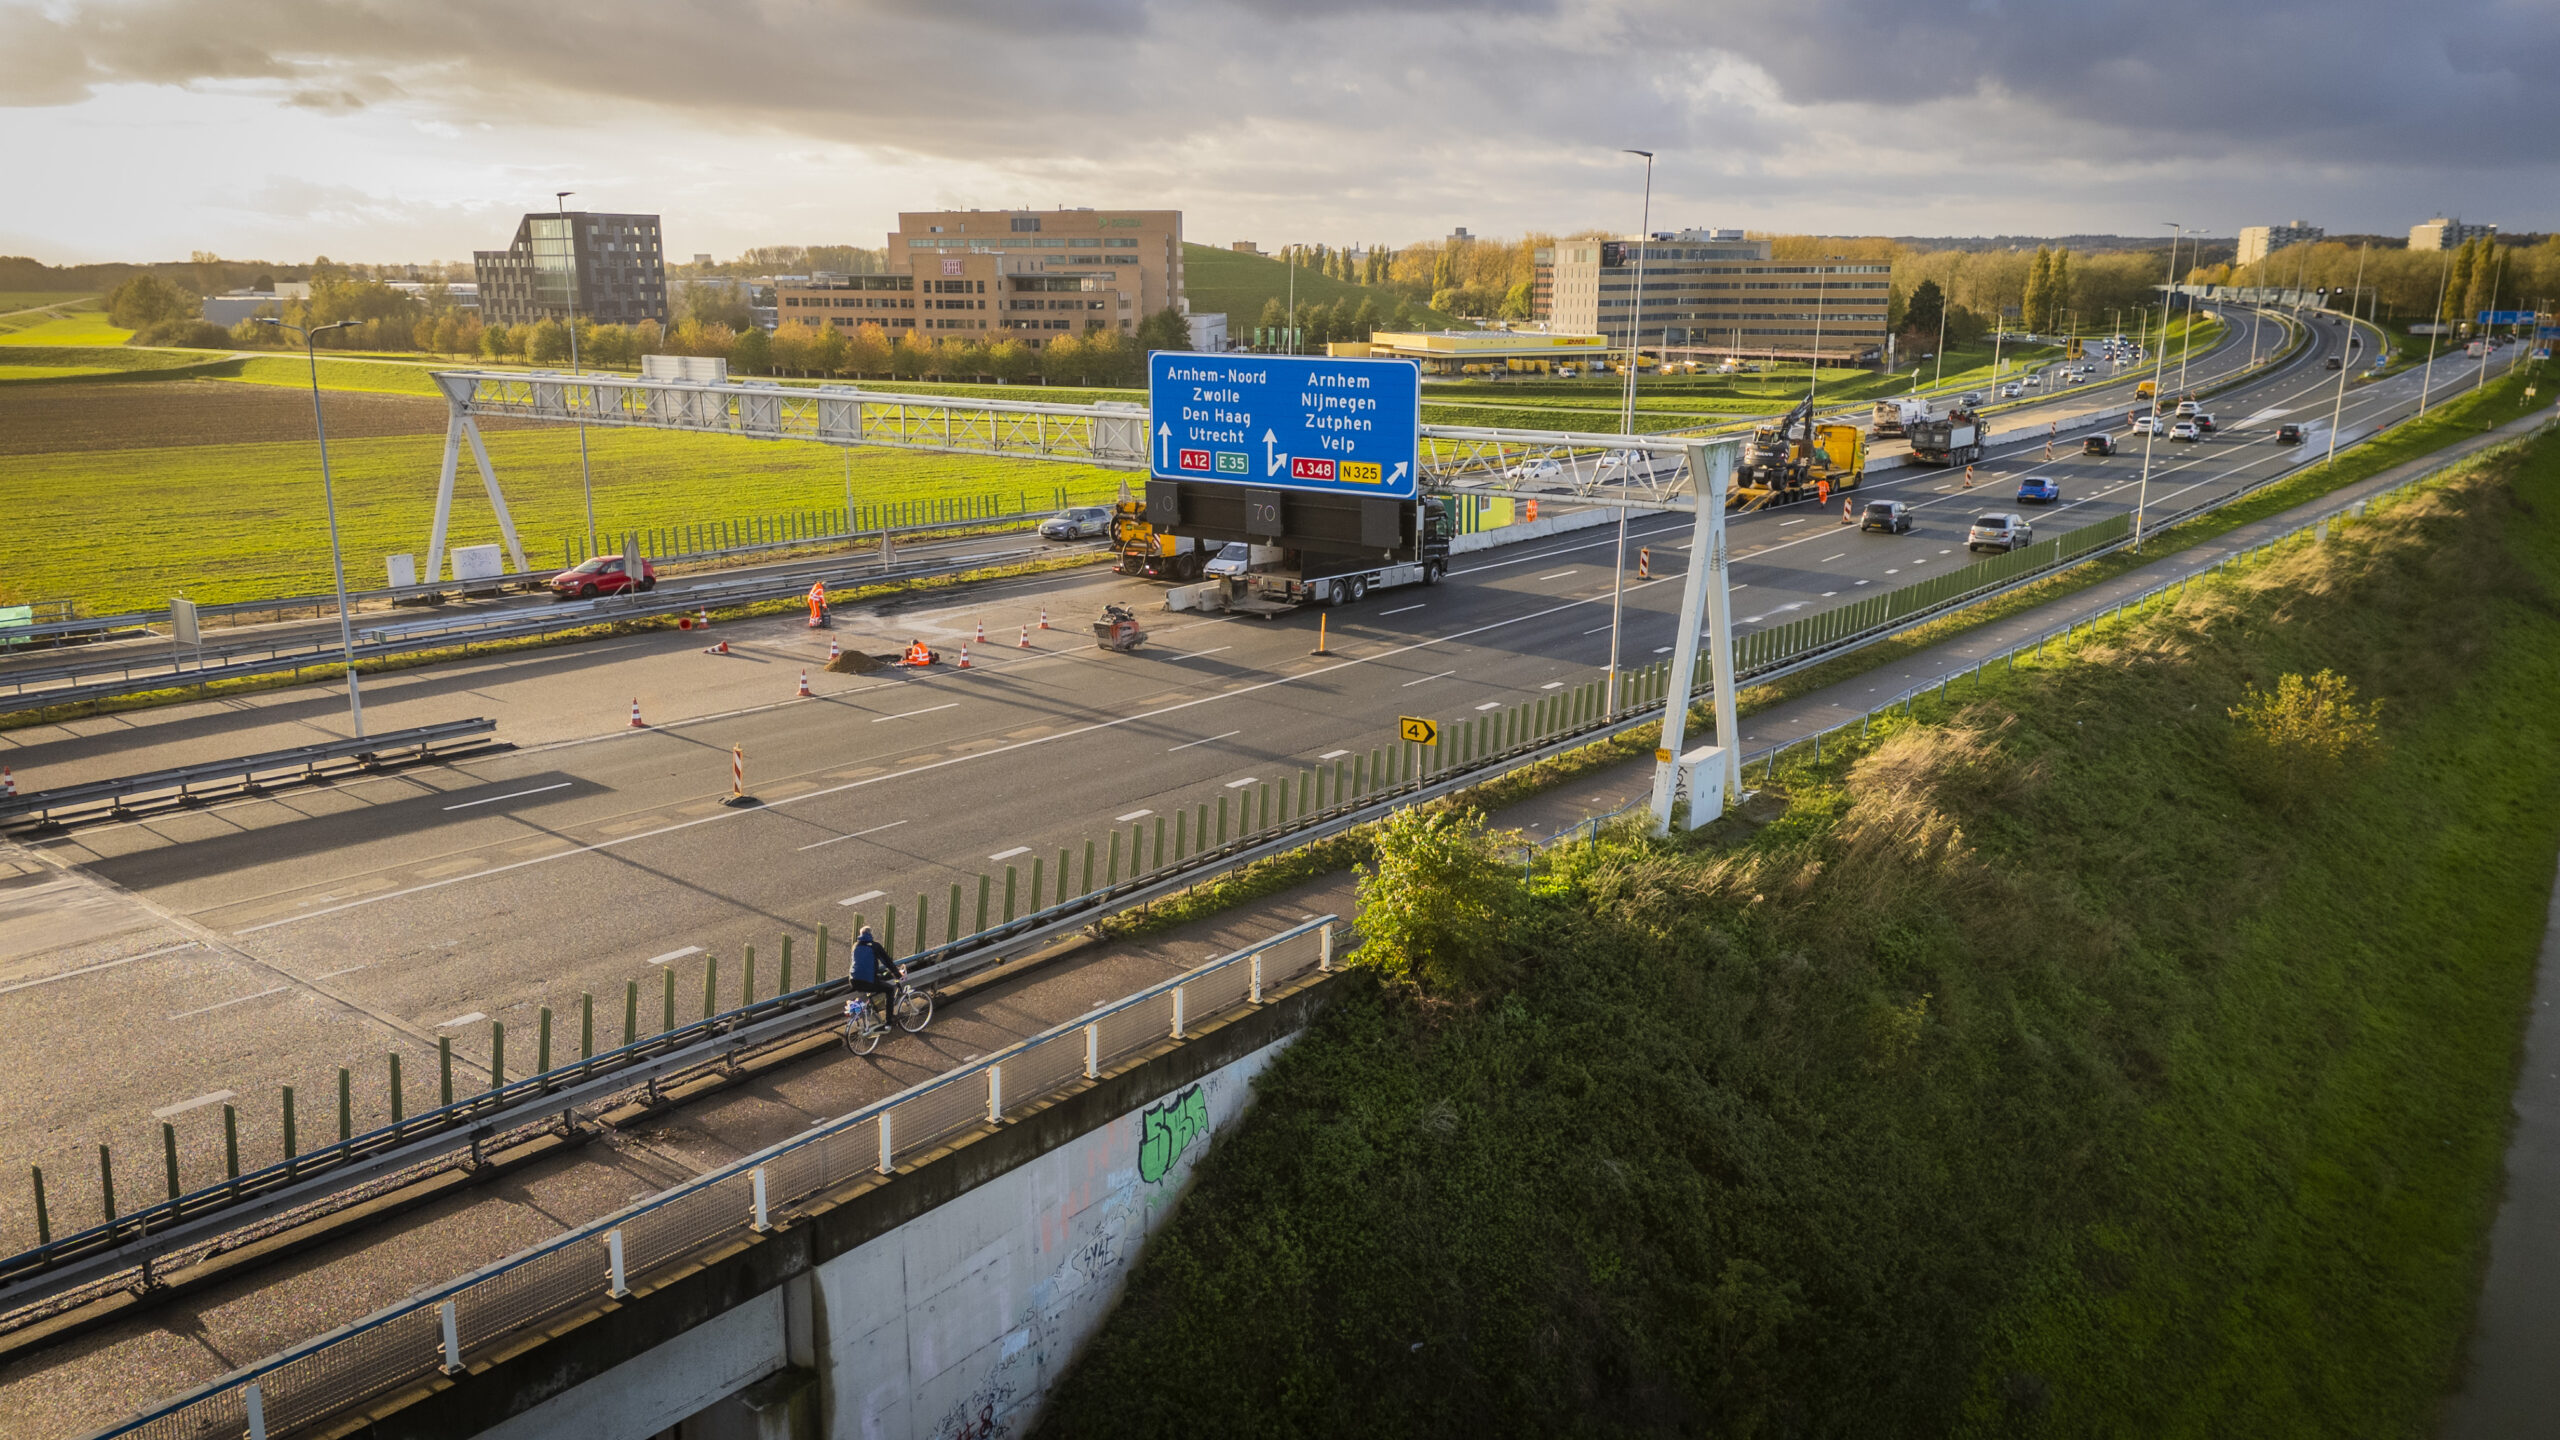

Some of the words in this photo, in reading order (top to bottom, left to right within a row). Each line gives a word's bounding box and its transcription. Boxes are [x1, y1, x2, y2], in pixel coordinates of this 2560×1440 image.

[1167, 366, 1267, 384] Arnhem-Noord
[1307, 372, 1370, 389] Arnhem
[1193, 387, 1240, 403] Zwolle
[1301, 392, 1376, 413] Nijmegen
[1182, 406, 1209, 421] Den
[1215, 408, 1251, 428] Haag
[1305, 413, 1372, 432] Zutphen
[1189, 427, 1244, 444] Utrecht
[1320, 435, 1355, 454] Velp
[1253, 503, 1276, 522] 70
[1407, 724, 1420, 738] 4
